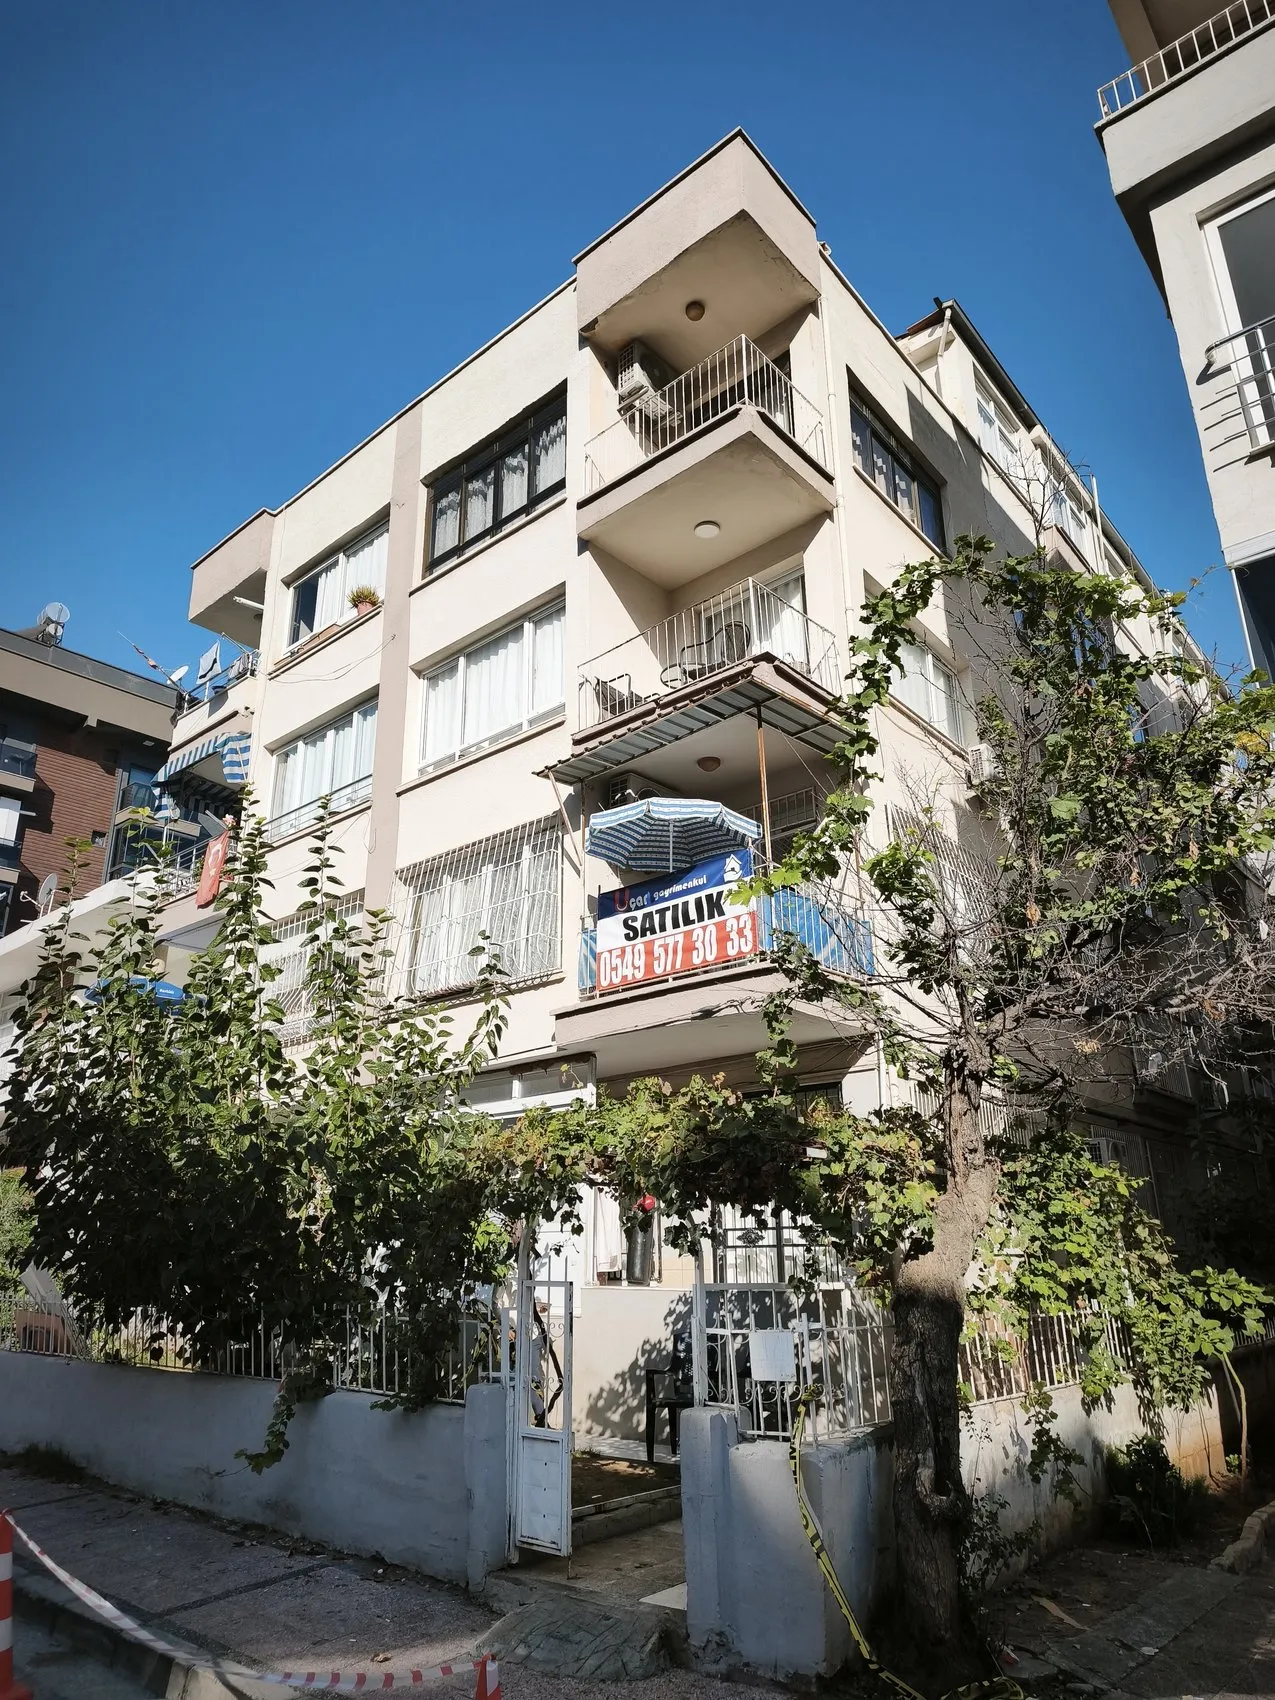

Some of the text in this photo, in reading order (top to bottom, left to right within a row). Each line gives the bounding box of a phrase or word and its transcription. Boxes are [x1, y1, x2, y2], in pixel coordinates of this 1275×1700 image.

[653, 874, 708, 900] gayrimenkul
[622, 890, 726, 942] SATILIK
[600, 914, 753, 987] 0549 577 30 33
